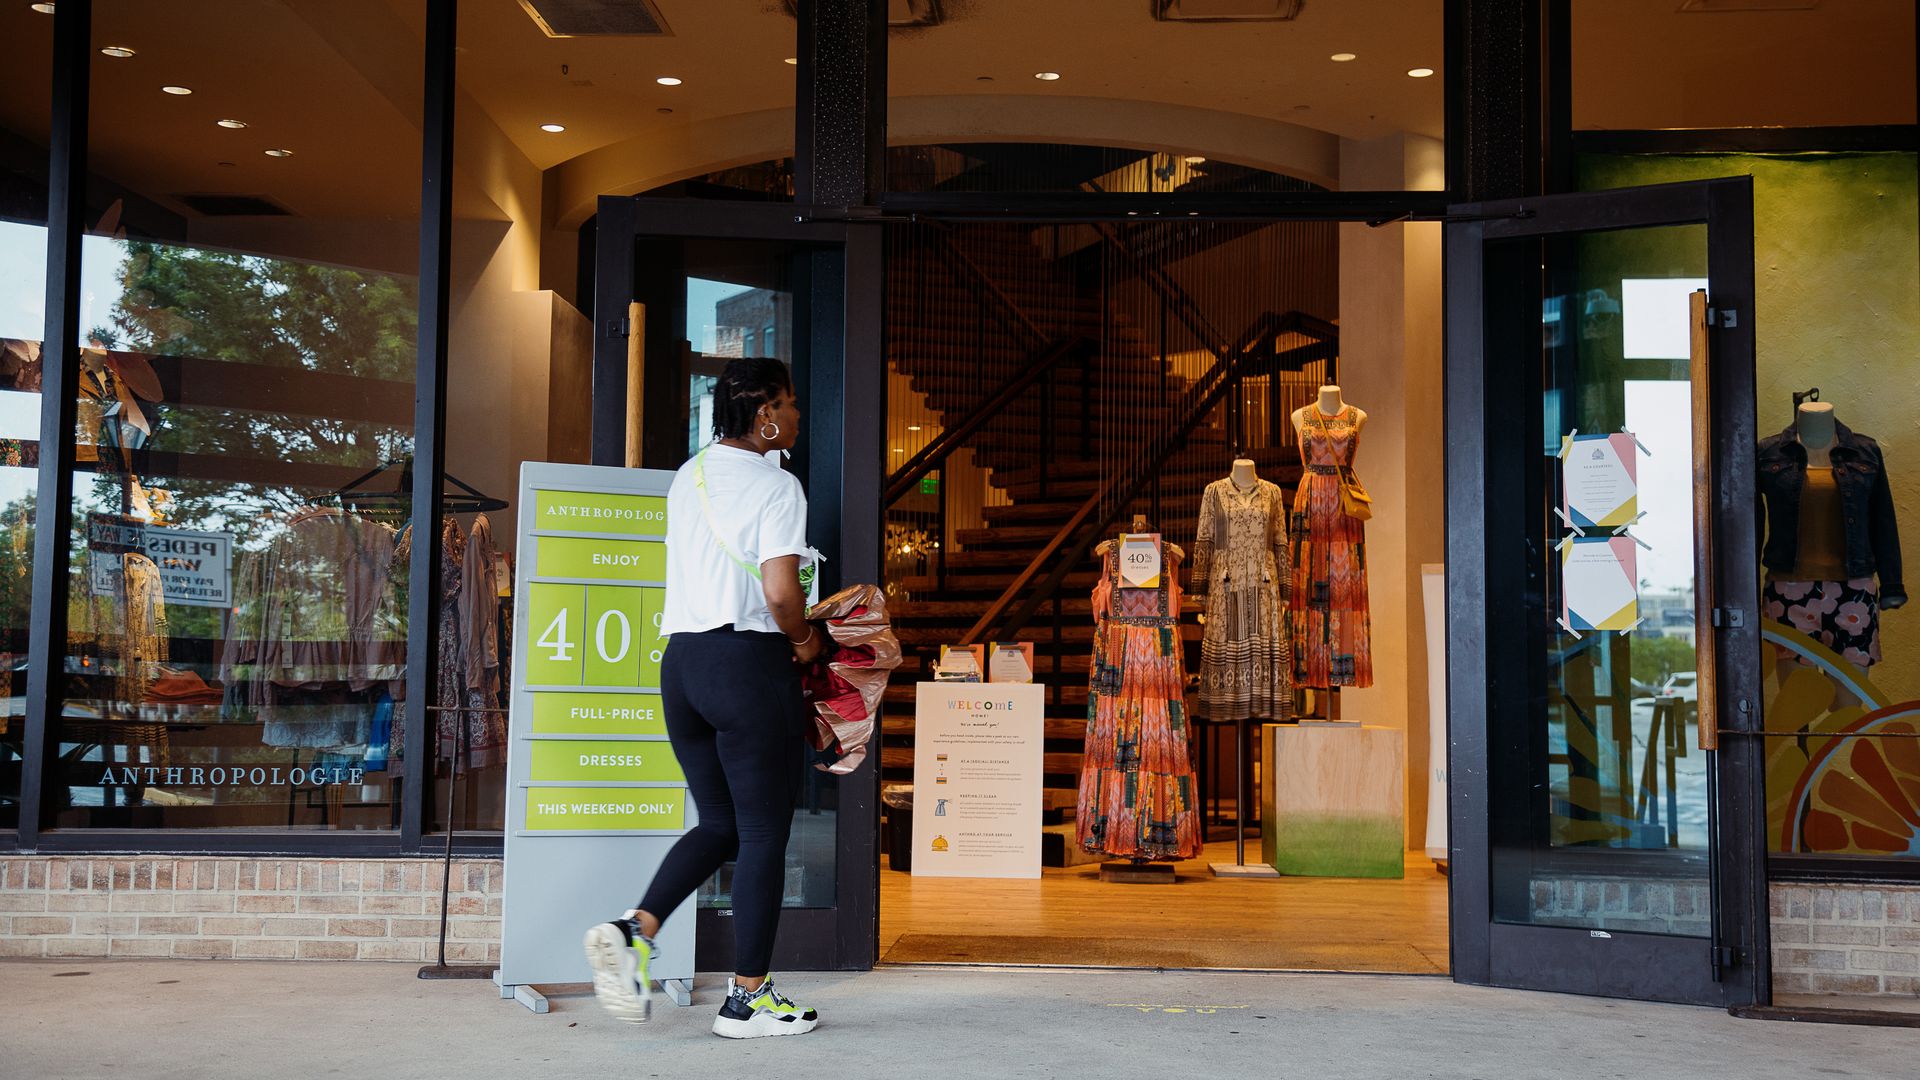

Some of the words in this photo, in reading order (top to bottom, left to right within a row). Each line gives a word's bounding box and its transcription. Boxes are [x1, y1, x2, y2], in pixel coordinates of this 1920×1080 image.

[547, 505, 664, 521] ANTHROPOLOG
[592, 553, 640, 567] ENJOY
[571, 708, 654, 720] FULL-PRICE
[579, 755, 642, 767] DRESSES
[98, 767, 364, 785] ANTHROPOLOGIE
[537, 803, 567, 815] THIS
[571, 803, 635, 815] WEEKEND
[638, 803, 674, 815] ONLY
